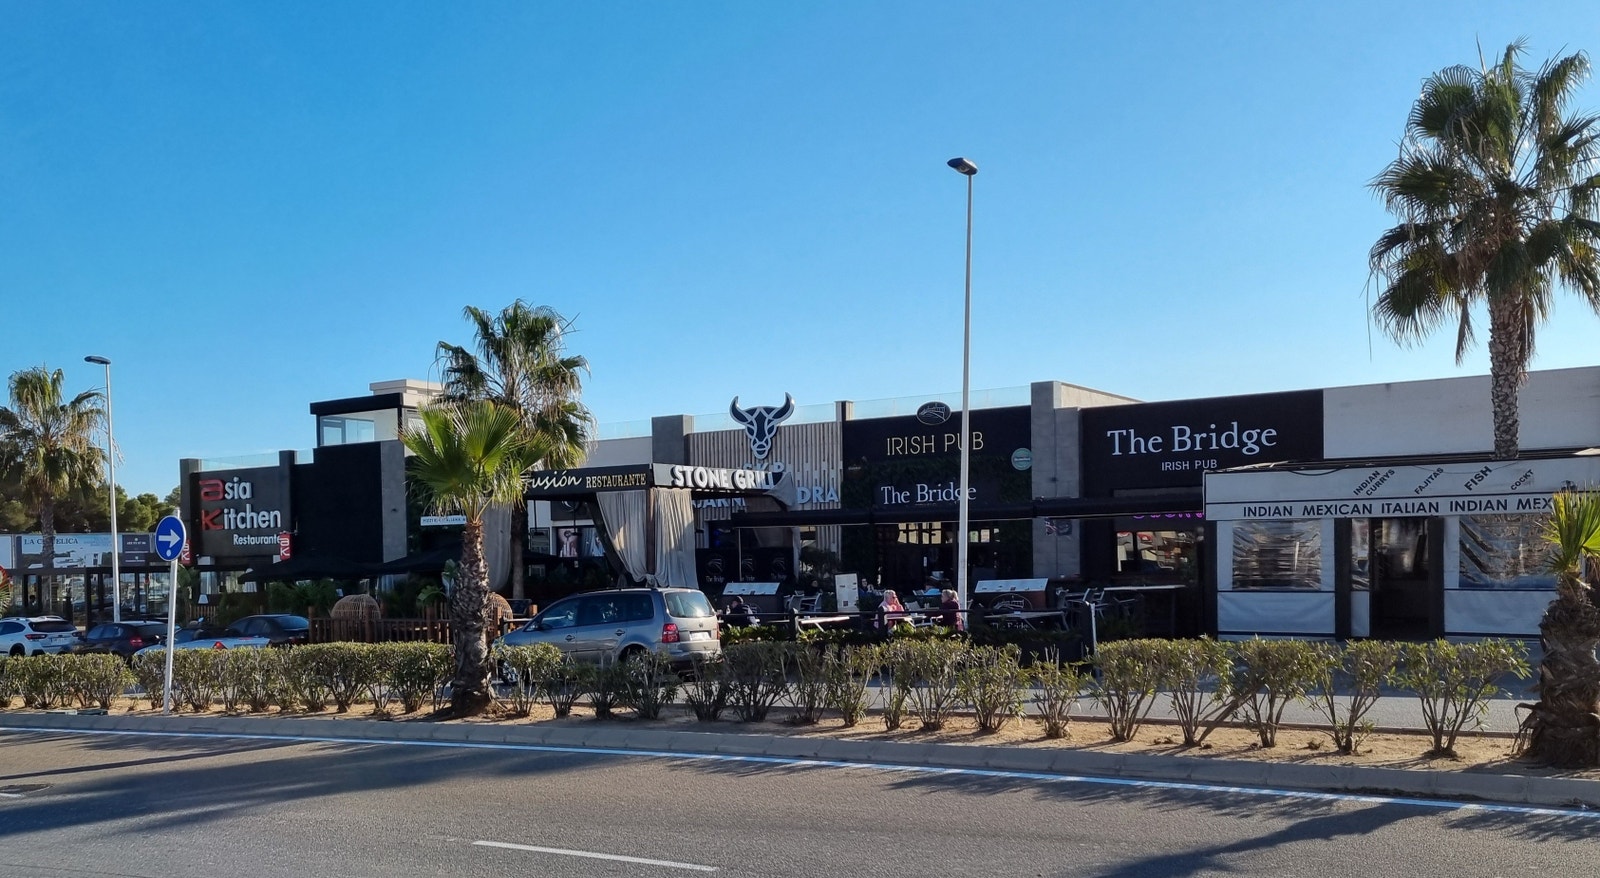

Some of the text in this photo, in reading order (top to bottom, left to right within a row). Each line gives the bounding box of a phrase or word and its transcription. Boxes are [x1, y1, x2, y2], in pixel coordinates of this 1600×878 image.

[887, 434, 935, 456] IRISH
[1107, 421, 1278, 455] The Bridge
[1161, 459, 1218, 471] IRISH PUB
[585, 472, 647, 489] RESTAURANTE
[672, 465, 729, 489] STONE
[732, 469, 776, 490] GRILL
[1353, 470, 1381, 496] INDIAN
[1365, 469, 1396, 496] CURRYS
[1414, 467, 1444, 495] FAJITAS
[1463, 465, 1493, 491] FISH
[796, 485, 839, 504] DRA
[880, 485, 910, 504] The
[1243, 497, 1553, 517] INDIAN MEXICAN ITALIAN INDIAN MEX
